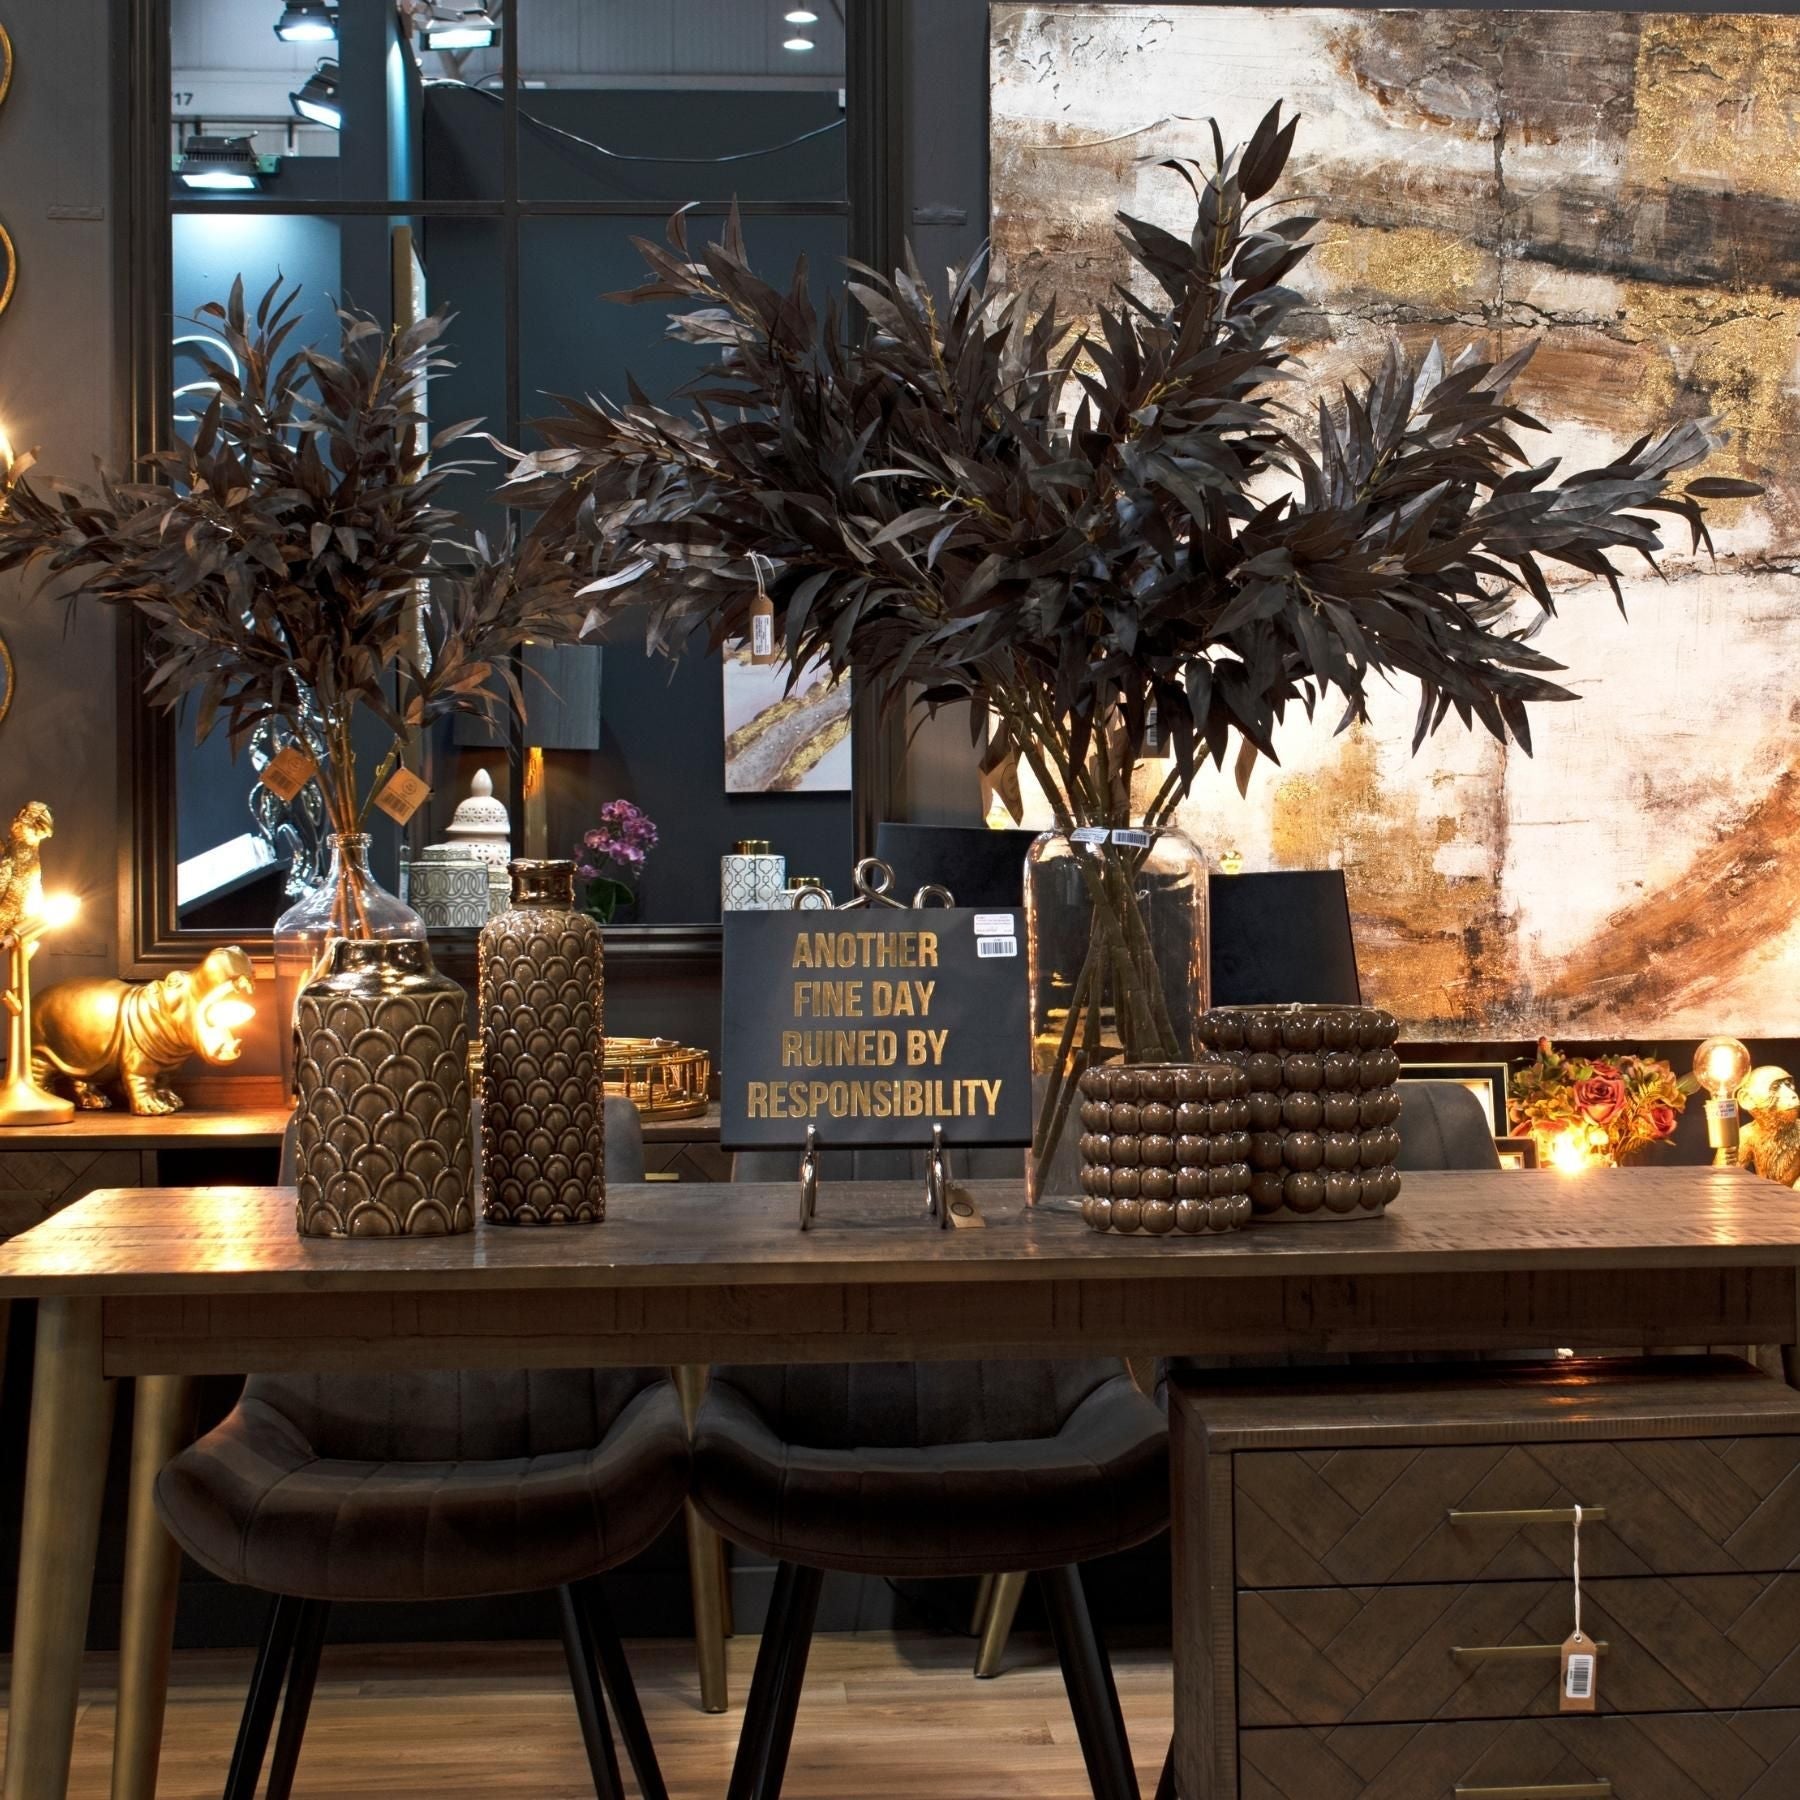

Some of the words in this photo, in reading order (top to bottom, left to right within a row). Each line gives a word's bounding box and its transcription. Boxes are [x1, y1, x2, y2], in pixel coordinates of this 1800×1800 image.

[792, 931, 939, 968] ANOTHER
[793, 981, 863, 1018] FINE
[872, 980, 936, 1017] DAY
[782, 1030, 897, 1068] RUINED
[907, 1029, 949, 1066] BY
[747, 1079, 1003, 1119] RESPONSIBILITY
